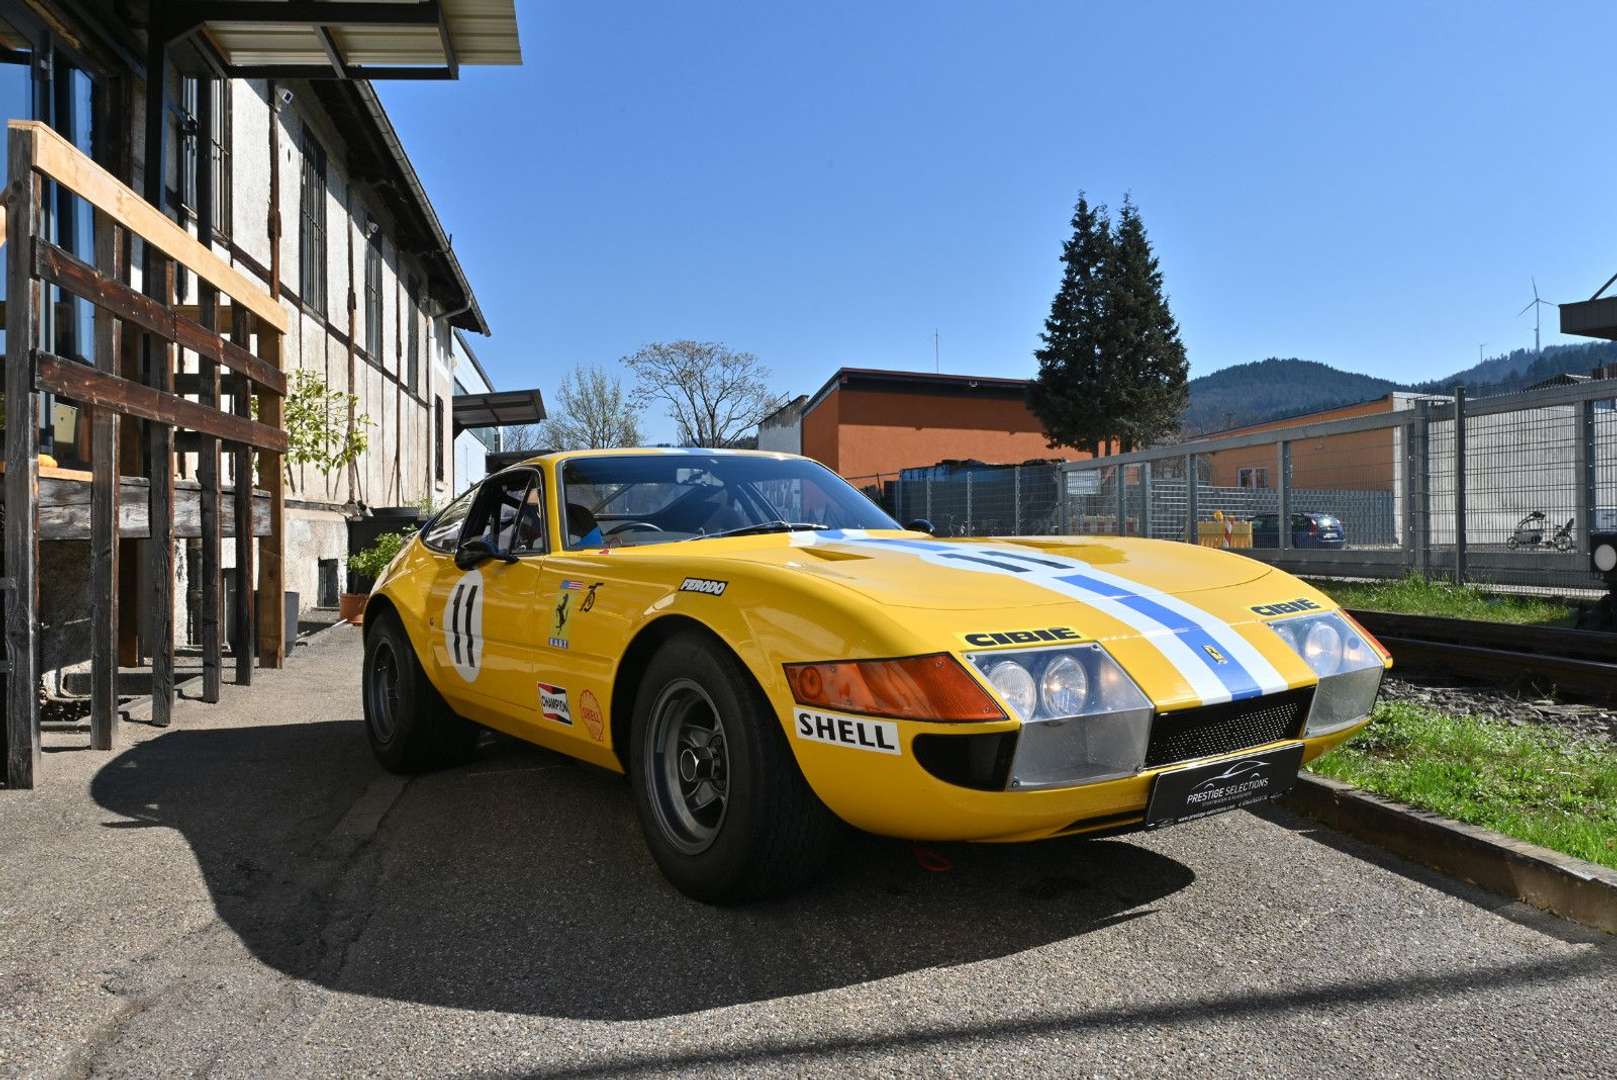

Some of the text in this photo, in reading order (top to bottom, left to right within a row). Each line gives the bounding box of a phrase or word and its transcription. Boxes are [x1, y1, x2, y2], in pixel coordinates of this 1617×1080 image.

[680, 577, 726, 595] FERODO
[452, 584, 478, 668] 11
[798, 712, 896, 750] SHELL
[1186, 786, 1224, 805] PRESTIGE
[1225, 777, 1269, 796] SELECTIONS
